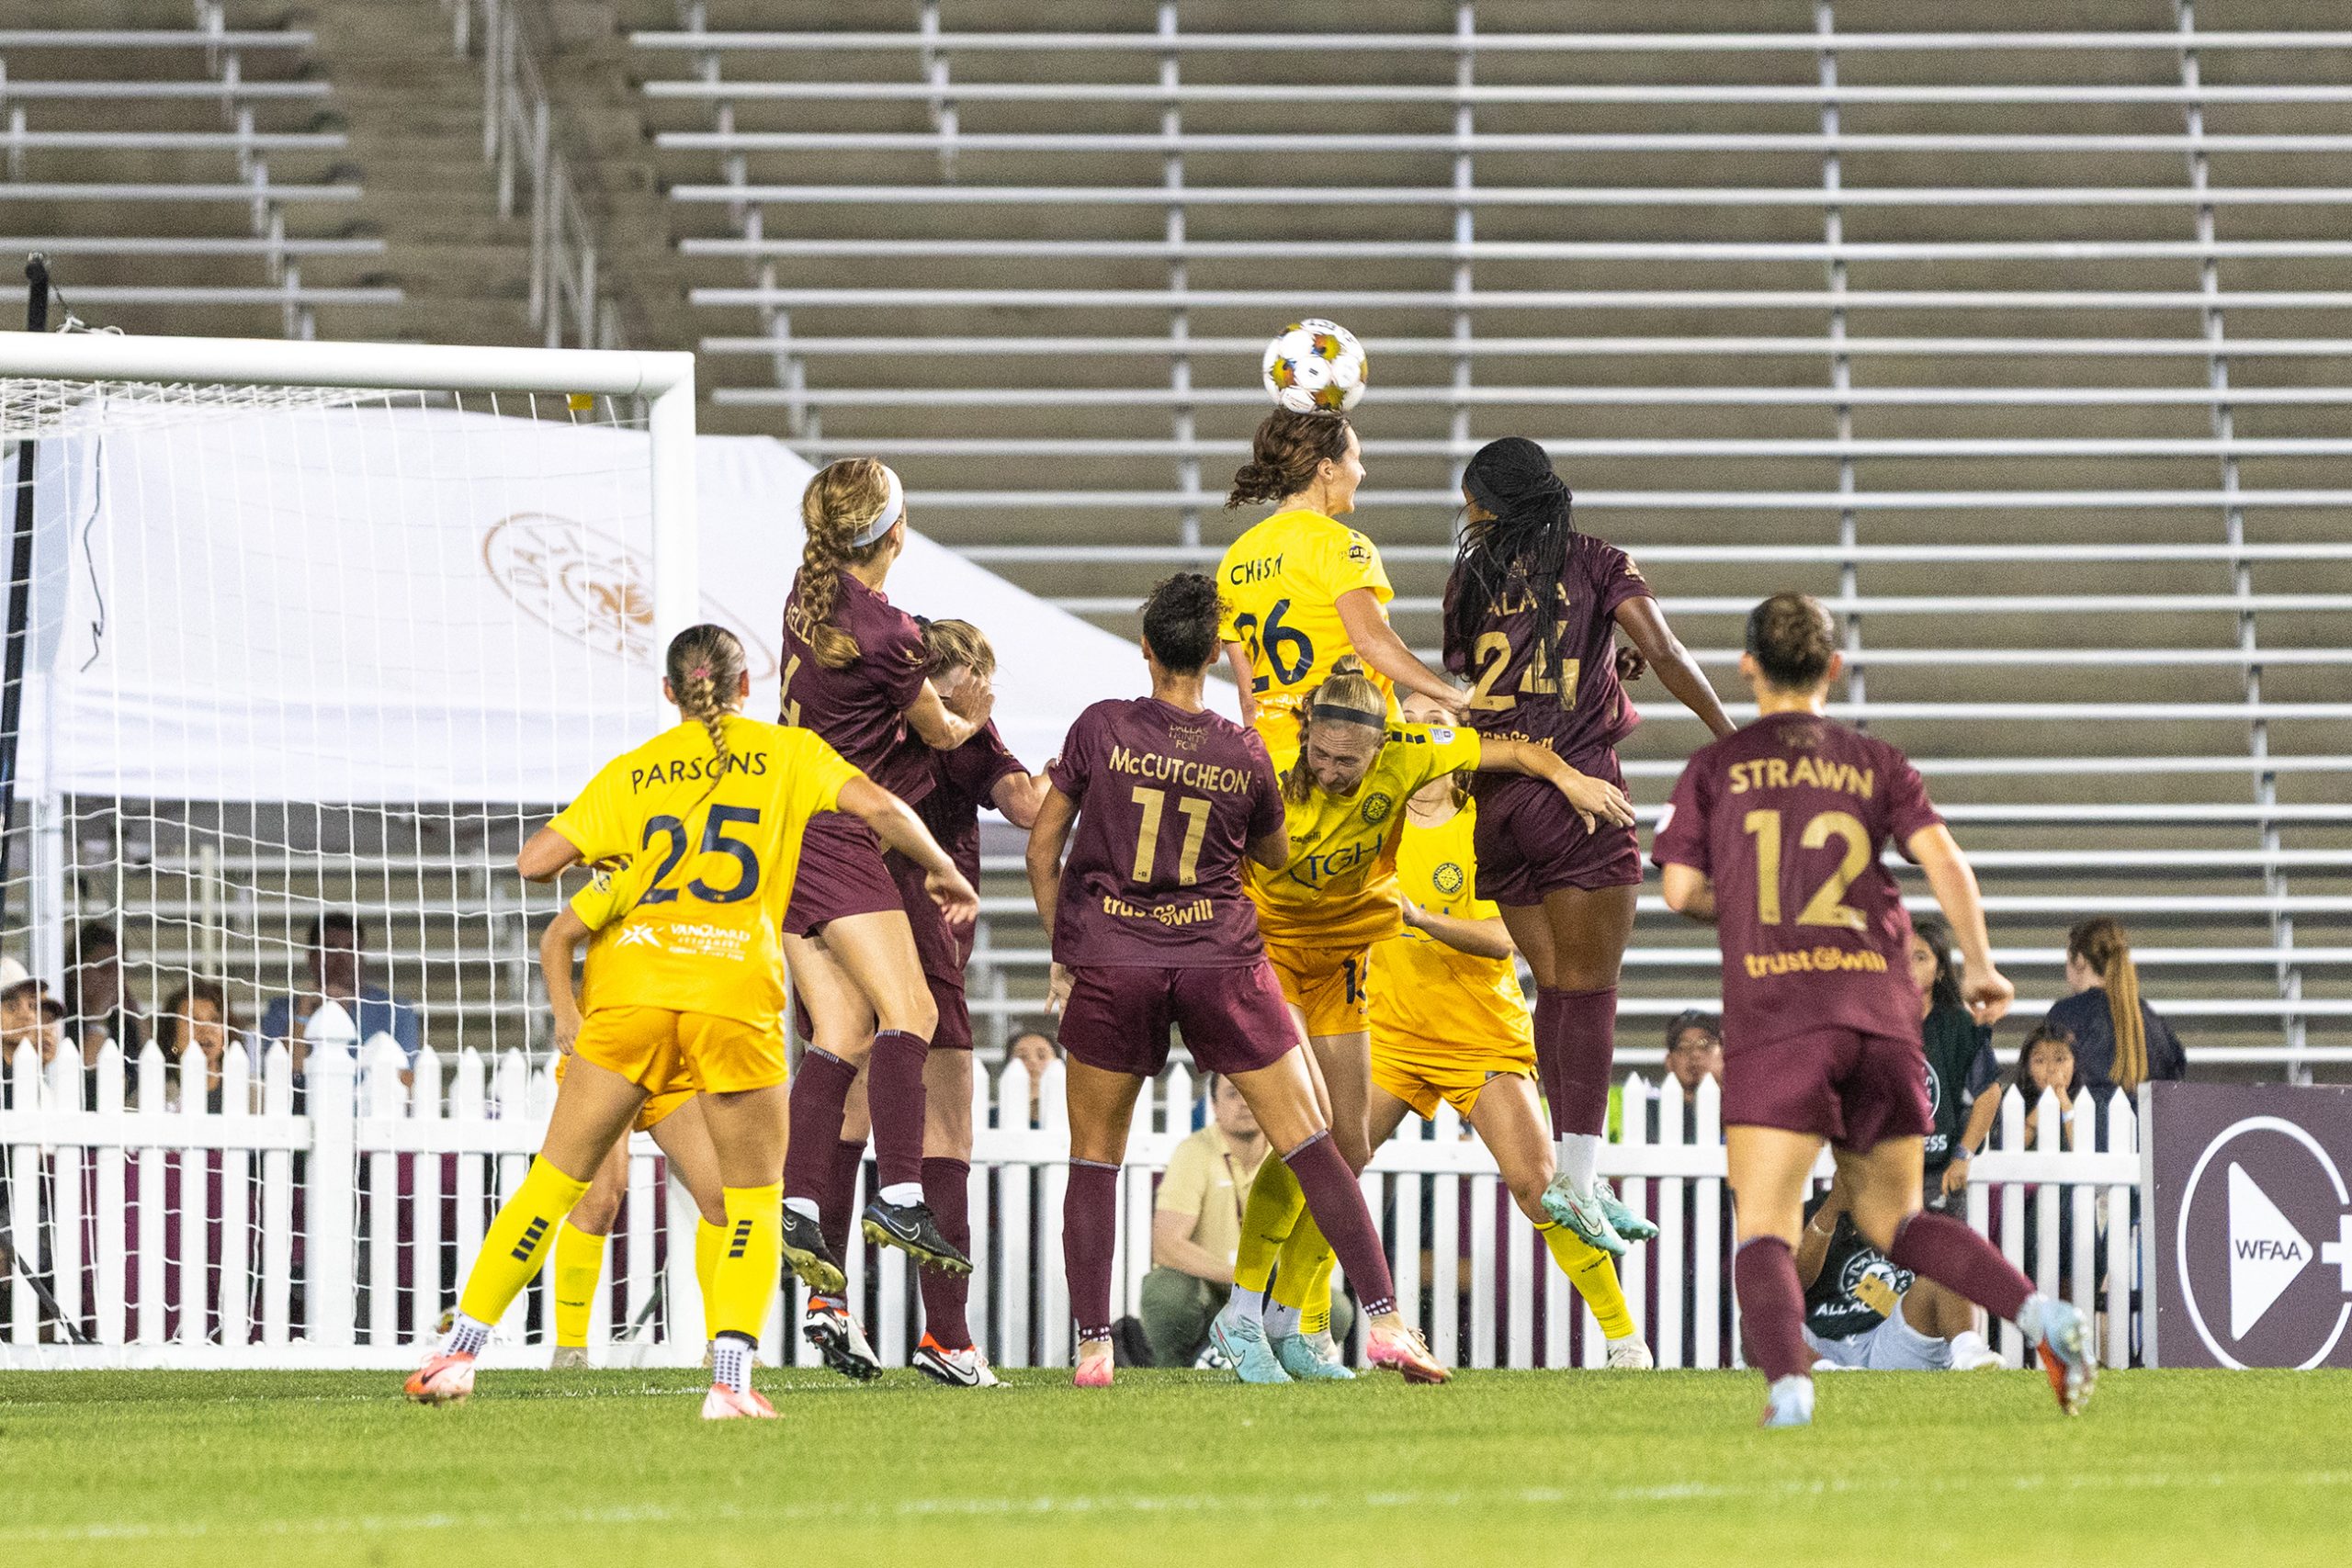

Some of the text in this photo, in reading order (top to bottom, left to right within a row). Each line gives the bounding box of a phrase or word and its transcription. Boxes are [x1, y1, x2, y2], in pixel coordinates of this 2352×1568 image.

[1233, 598, 1314, 694] 26
[1469, 616, 1580, 712] 24
[631, 751, 767, 795] PARSONS
[1108, 745, 1251, 795] McCUTCHEON
[1728, 756, 1875, 800] STRAWN
[632, 804, 761, 910] 25
[1131, 785, 1212, 886] 11
[1306, 832, 1383, 881] TGH
[1743, 808, 1872, 931] 12
[2235, 1239, 2302, 1260] WFAA
